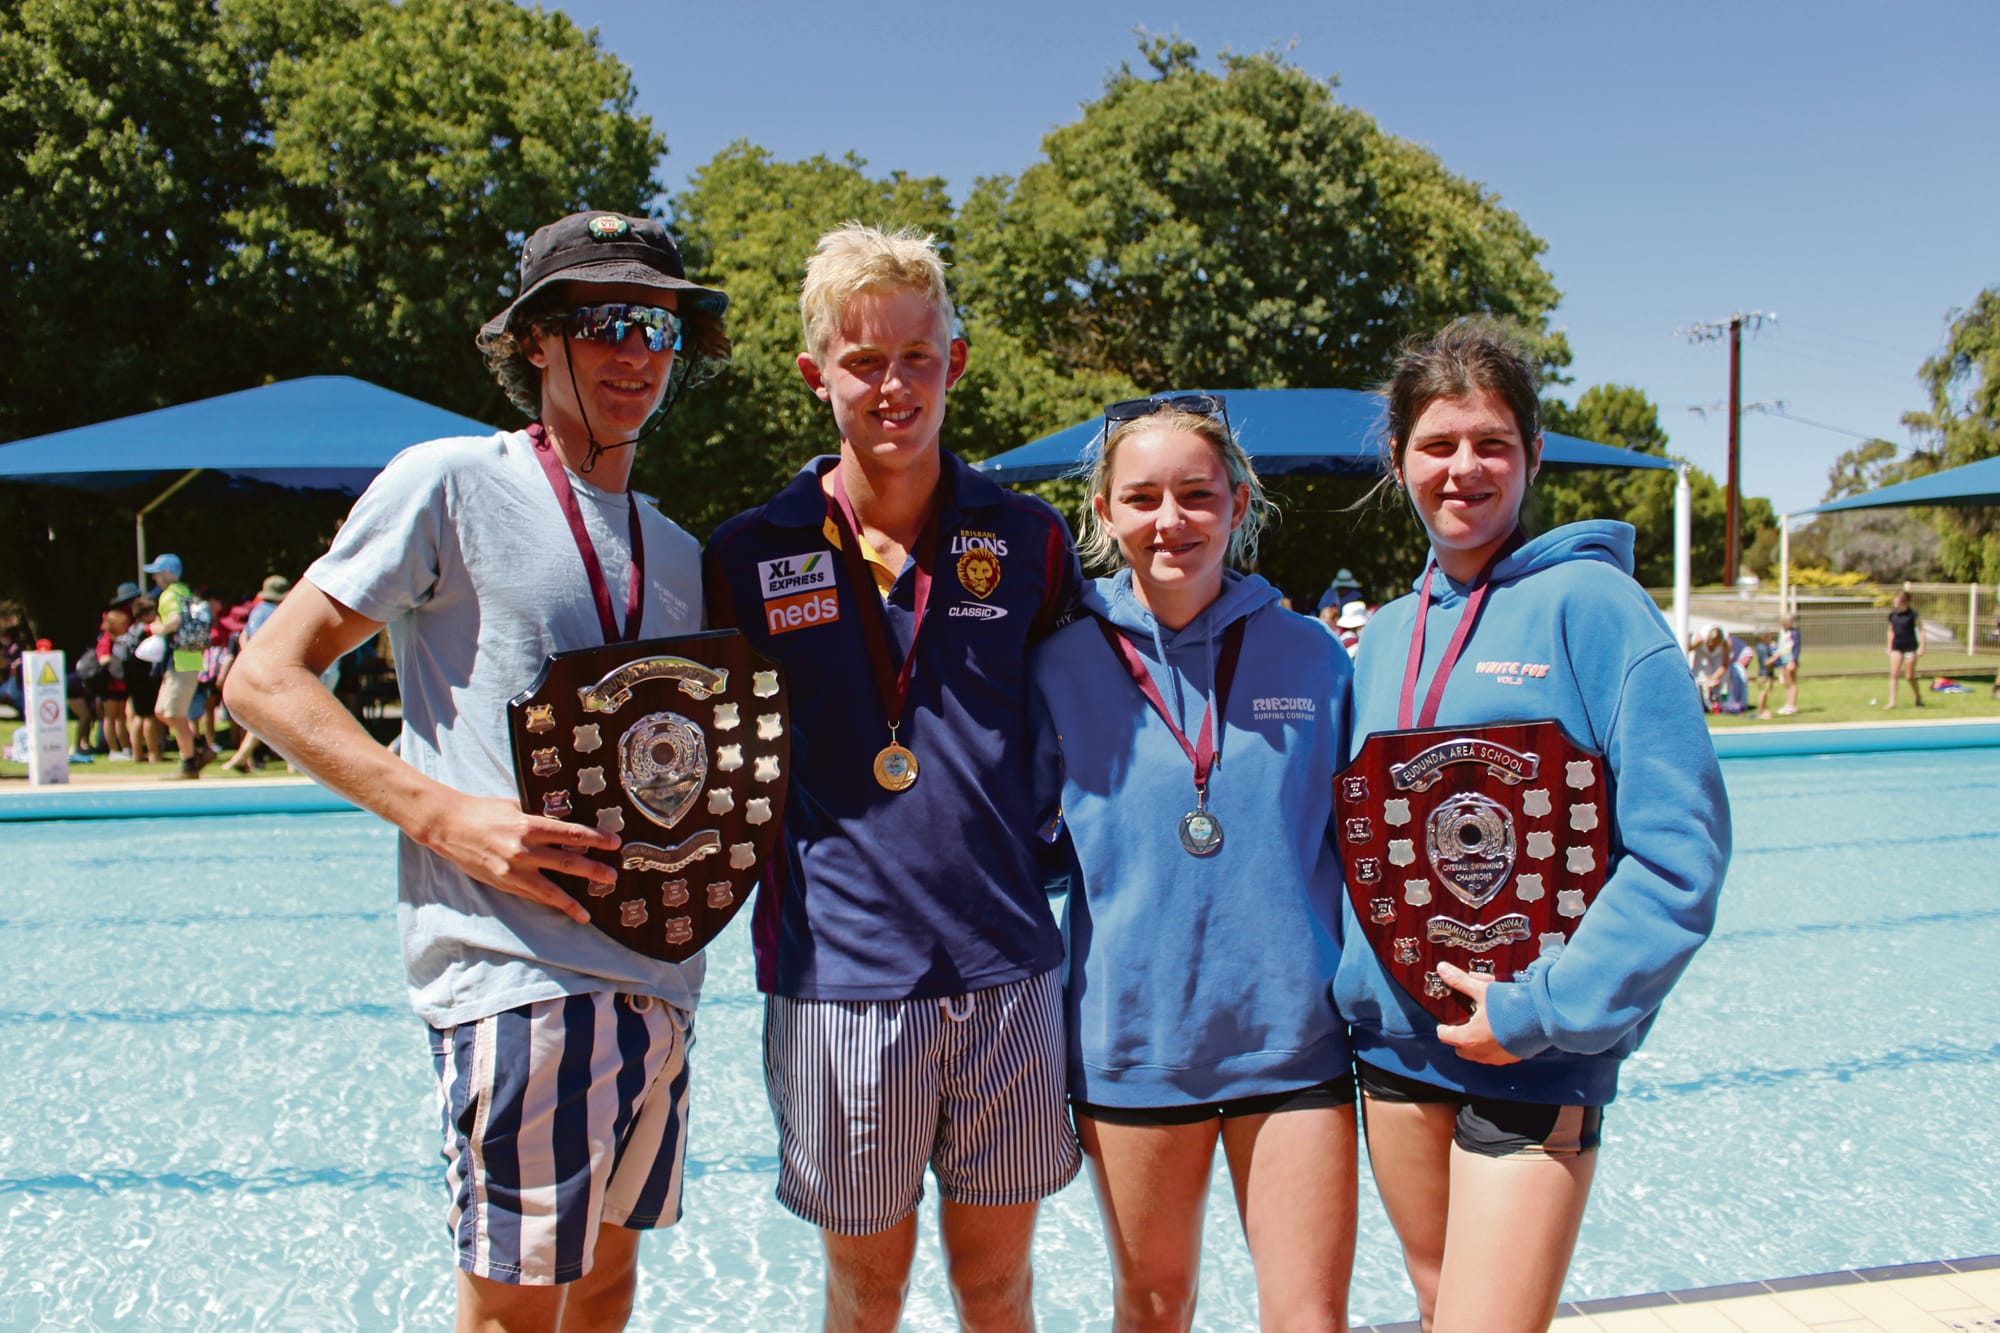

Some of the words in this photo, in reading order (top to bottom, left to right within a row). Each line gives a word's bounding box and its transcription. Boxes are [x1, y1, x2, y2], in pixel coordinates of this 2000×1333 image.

[960, 529, 996, 539] BRISBANE
[950, 535, 1009, 557] LIONS
[768, 559, 796, 580] XL
[769, 572, 825, 592] EXPRESS
[769, 595, 838, 631] neds
[948, 606, 992, 617] CLASSIC
[1475, 661, 1520, 675] WHITE
[1520, 663, 1551, 679] FOX
[1254, 711, 1285, 720] SURFING
[1286, 711, 1316, 720] COMPANY
[1403, 751, 1446, 781] EUDUNDA
[1449, 745, 1476, 758] AREA
[1480, 746, 1525, 773] SCHOOL
[1442, 863, 1470, 872] OVERALL
[1470, 861, 1505, 871] SWIMMING
[1455, 872, 1493, 882] CHAMPIONS
[1430, 921, 1477, 940] SWIMMING
[1485, 919, 1525, 938] CARNIVAL
